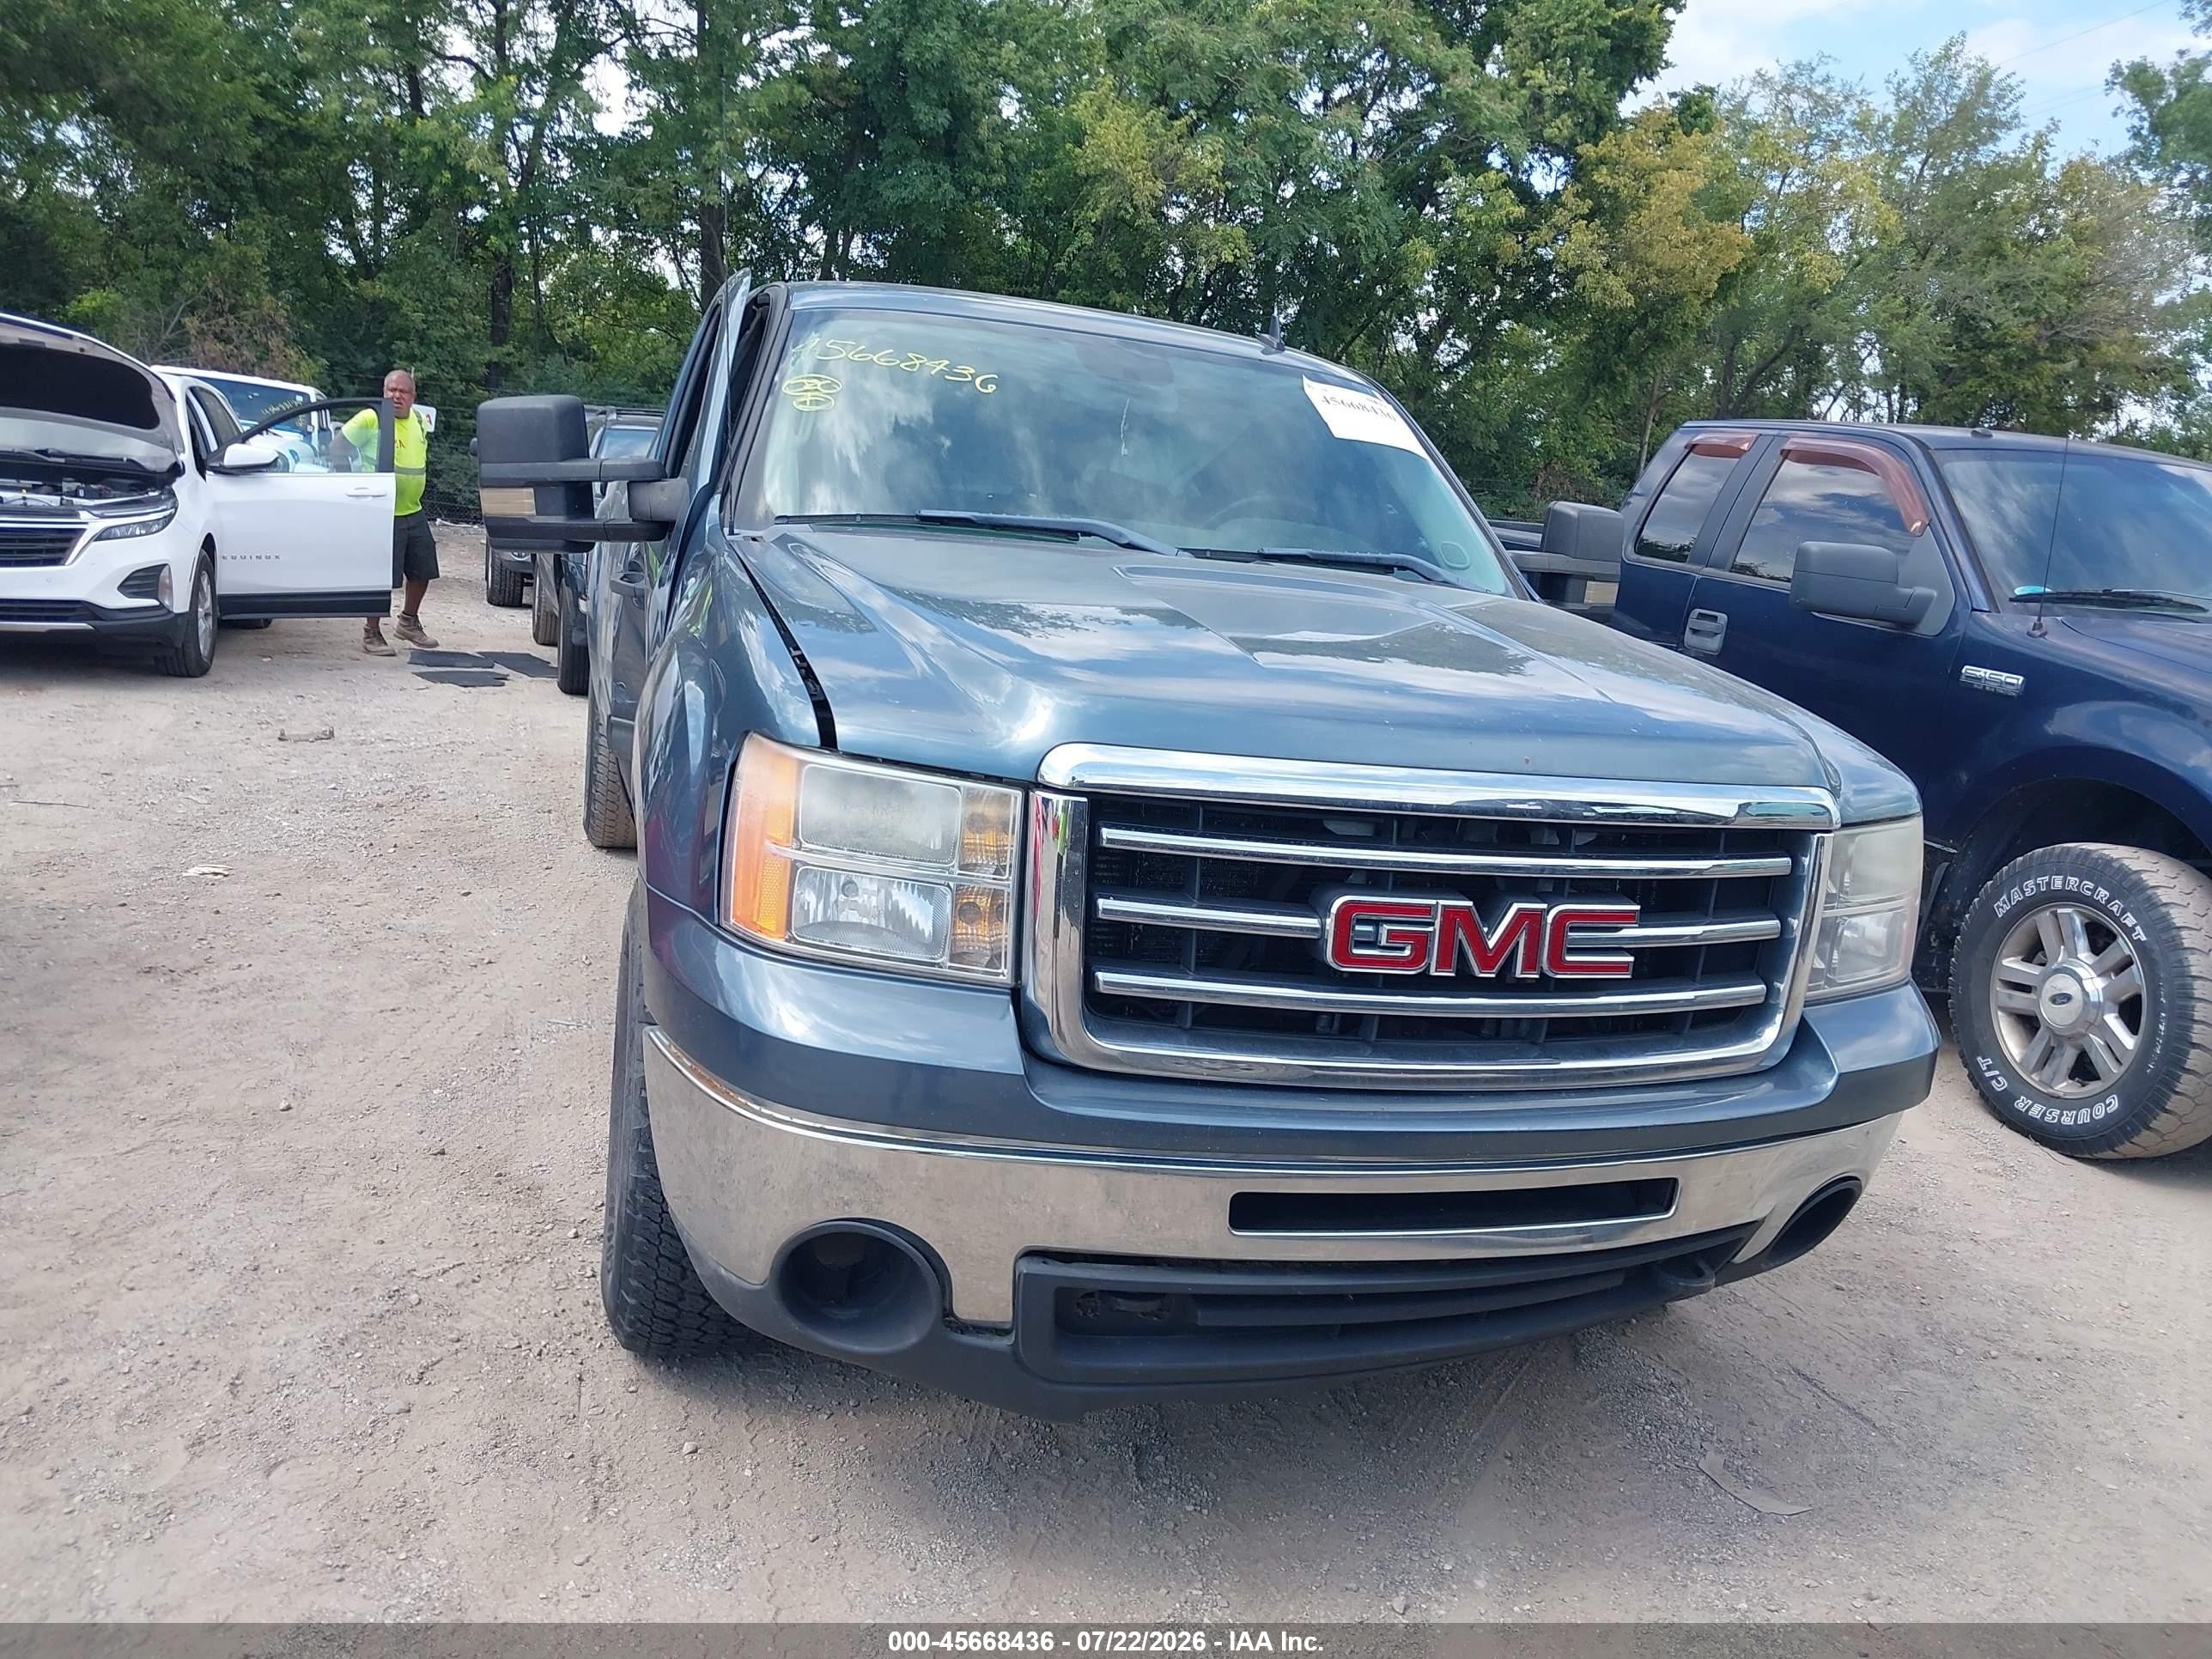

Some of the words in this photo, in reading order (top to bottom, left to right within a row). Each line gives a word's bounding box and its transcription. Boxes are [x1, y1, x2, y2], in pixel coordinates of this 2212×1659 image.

[1325, 895, 1641, 979] GMC
[1994, 875, 2147, 942] MASTERCRAFT
[2014, 1094, 2118, 1125] COURSER
